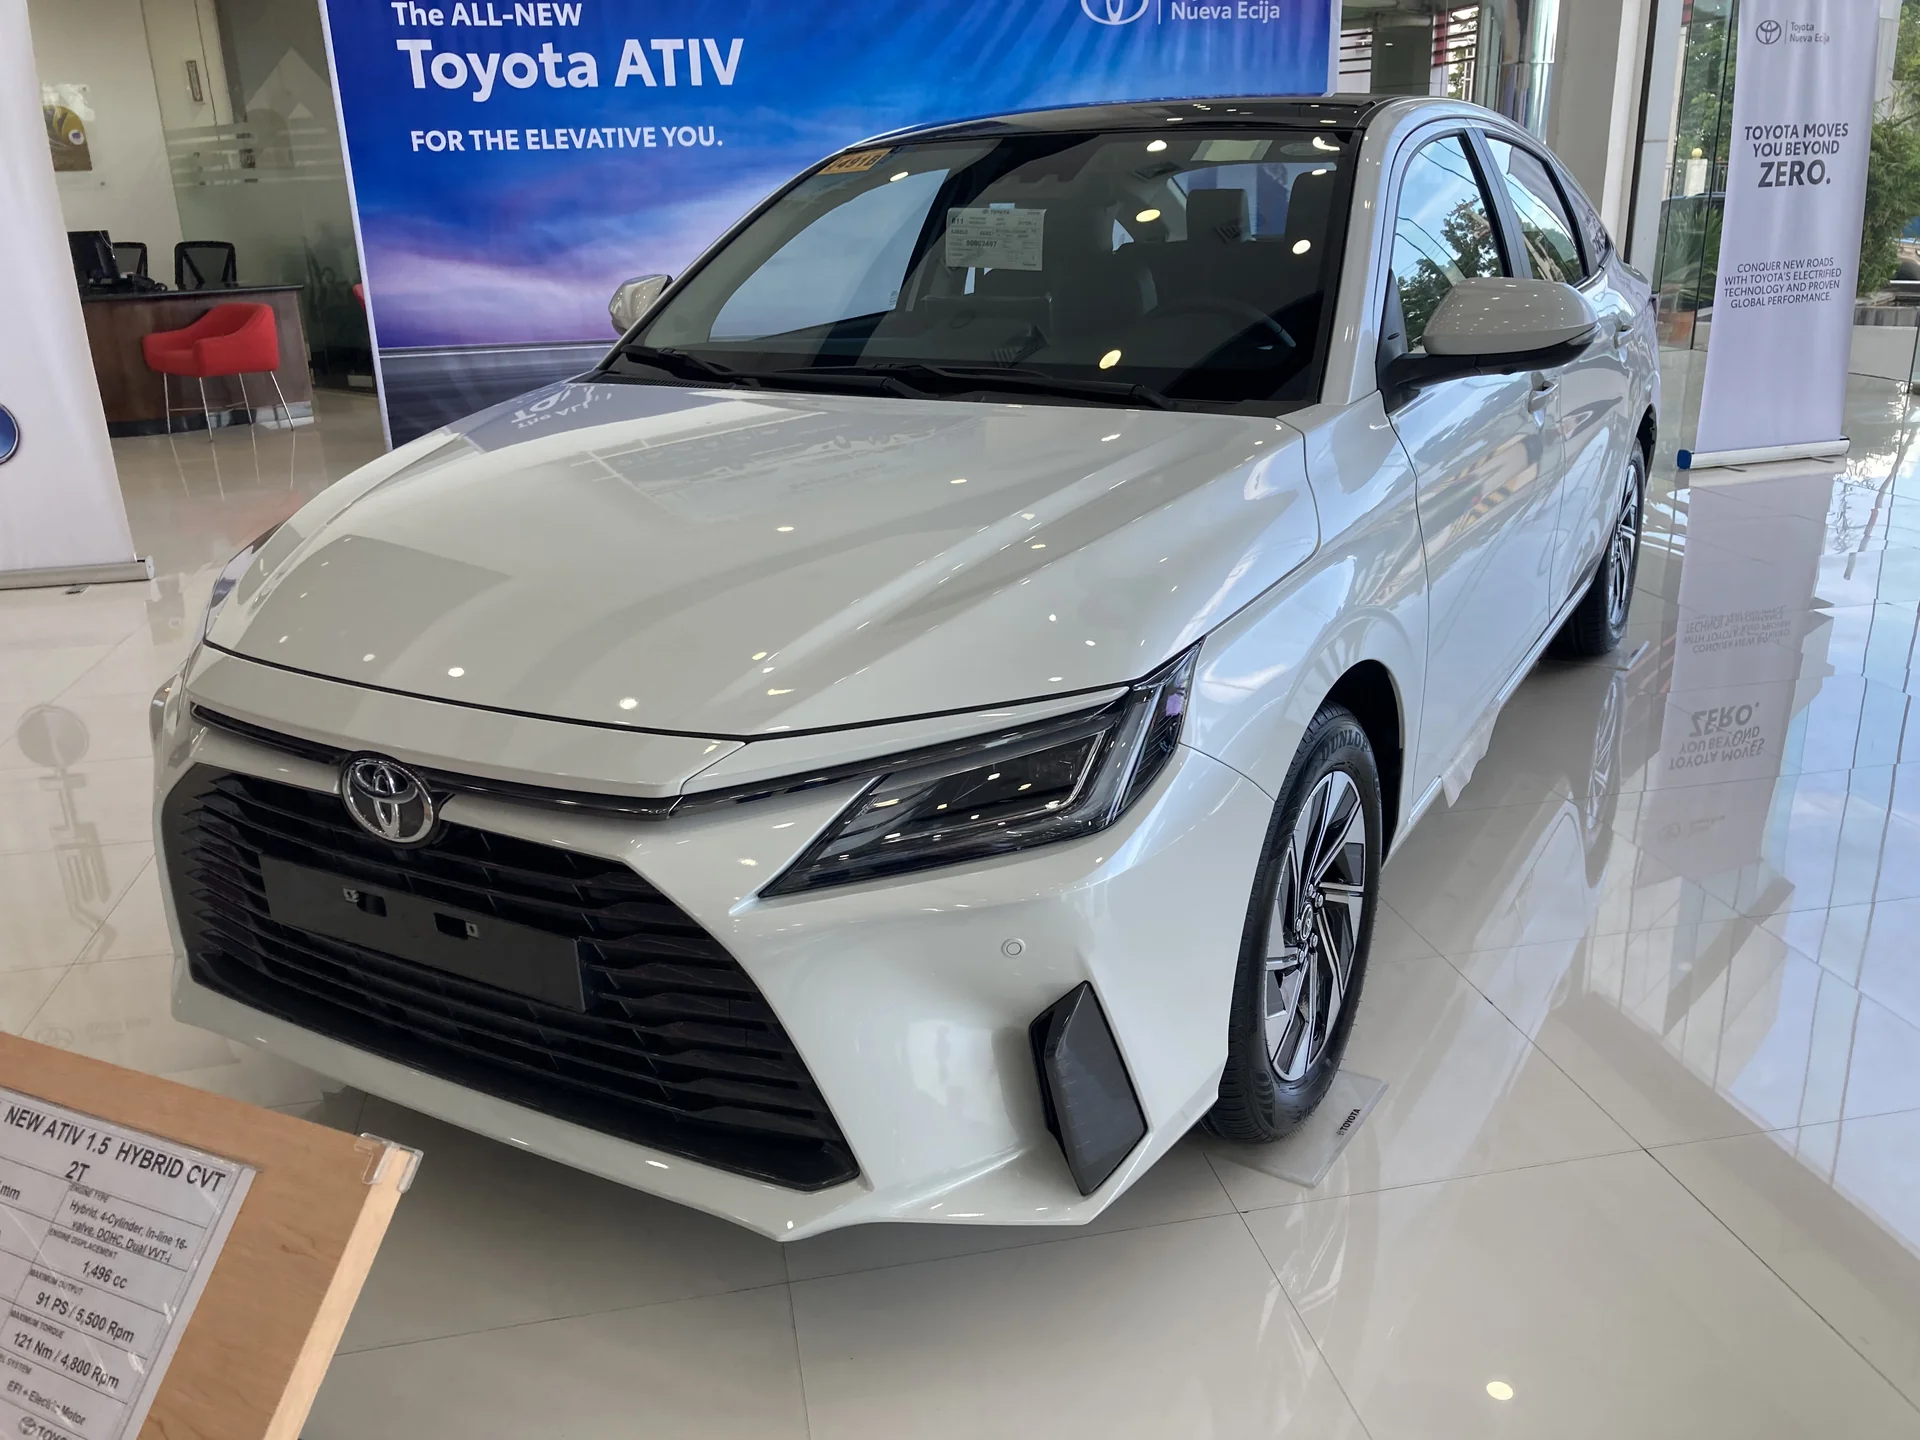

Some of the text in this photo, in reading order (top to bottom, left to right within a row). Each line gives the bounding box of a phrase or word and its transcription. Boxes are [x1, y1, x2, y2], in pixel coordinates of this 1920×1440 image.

[391, 2, 582, 27] The ALL-NEW
[1171, 1, 1280, 24] Nueva Ecija
[1790, 21, 1815, 32] Toyota
[1789, 33, 1830, 44] Nueva Ecija
[396, 37, 744, 103] Toyota ATIV
[411, 125, 724, 152] FOR THE ELEVATIVE YOU.
[1745, 122, 1849, 141] TOYOTA MOVES
[1753, 140, 1840, 158] YOU BEYOND
[1757, 160, 1831, 188] ZERO.
[1737, 257, 1834, 273] CONQUER NEW ROADS
[1725, 268, 1842, 286] WITH TOYOTA'S ELECTRIFIED
[1724, 280, 1840, 297] TECHNOLOGY AND PROVEN
[1730, 291, 1832, 309] GLOBAL PERFORMANCE.
[1321, 728, 1370, 762] DUNLOP
[1340, 1108, 1361, 1131] TOYOTA
[4, 1105, 226, 1192] NEW ATIV 1.5 HYBRID CVT
[65, 1160, 90, 1182] 2T
[100, 1211, 143, 1237] 4-Cylinder,
[70, 1236, 119, 1259] DISPLACEMENT
[125, 1238, 147, 1255] Dual
[82, 1260, 128, 1289] 1,496 cc
[36, 1291, 135, 1344] 91 PS / 5,500 Rpm
[39, 1321, 66, 1339] TORQUE
[6, 1358, 33, 1375] SYSTEM
[13, 1331, 120, 1389] 121 Nm / 4,800 Rpm
[6, 1380, 23, 1394] EFI
